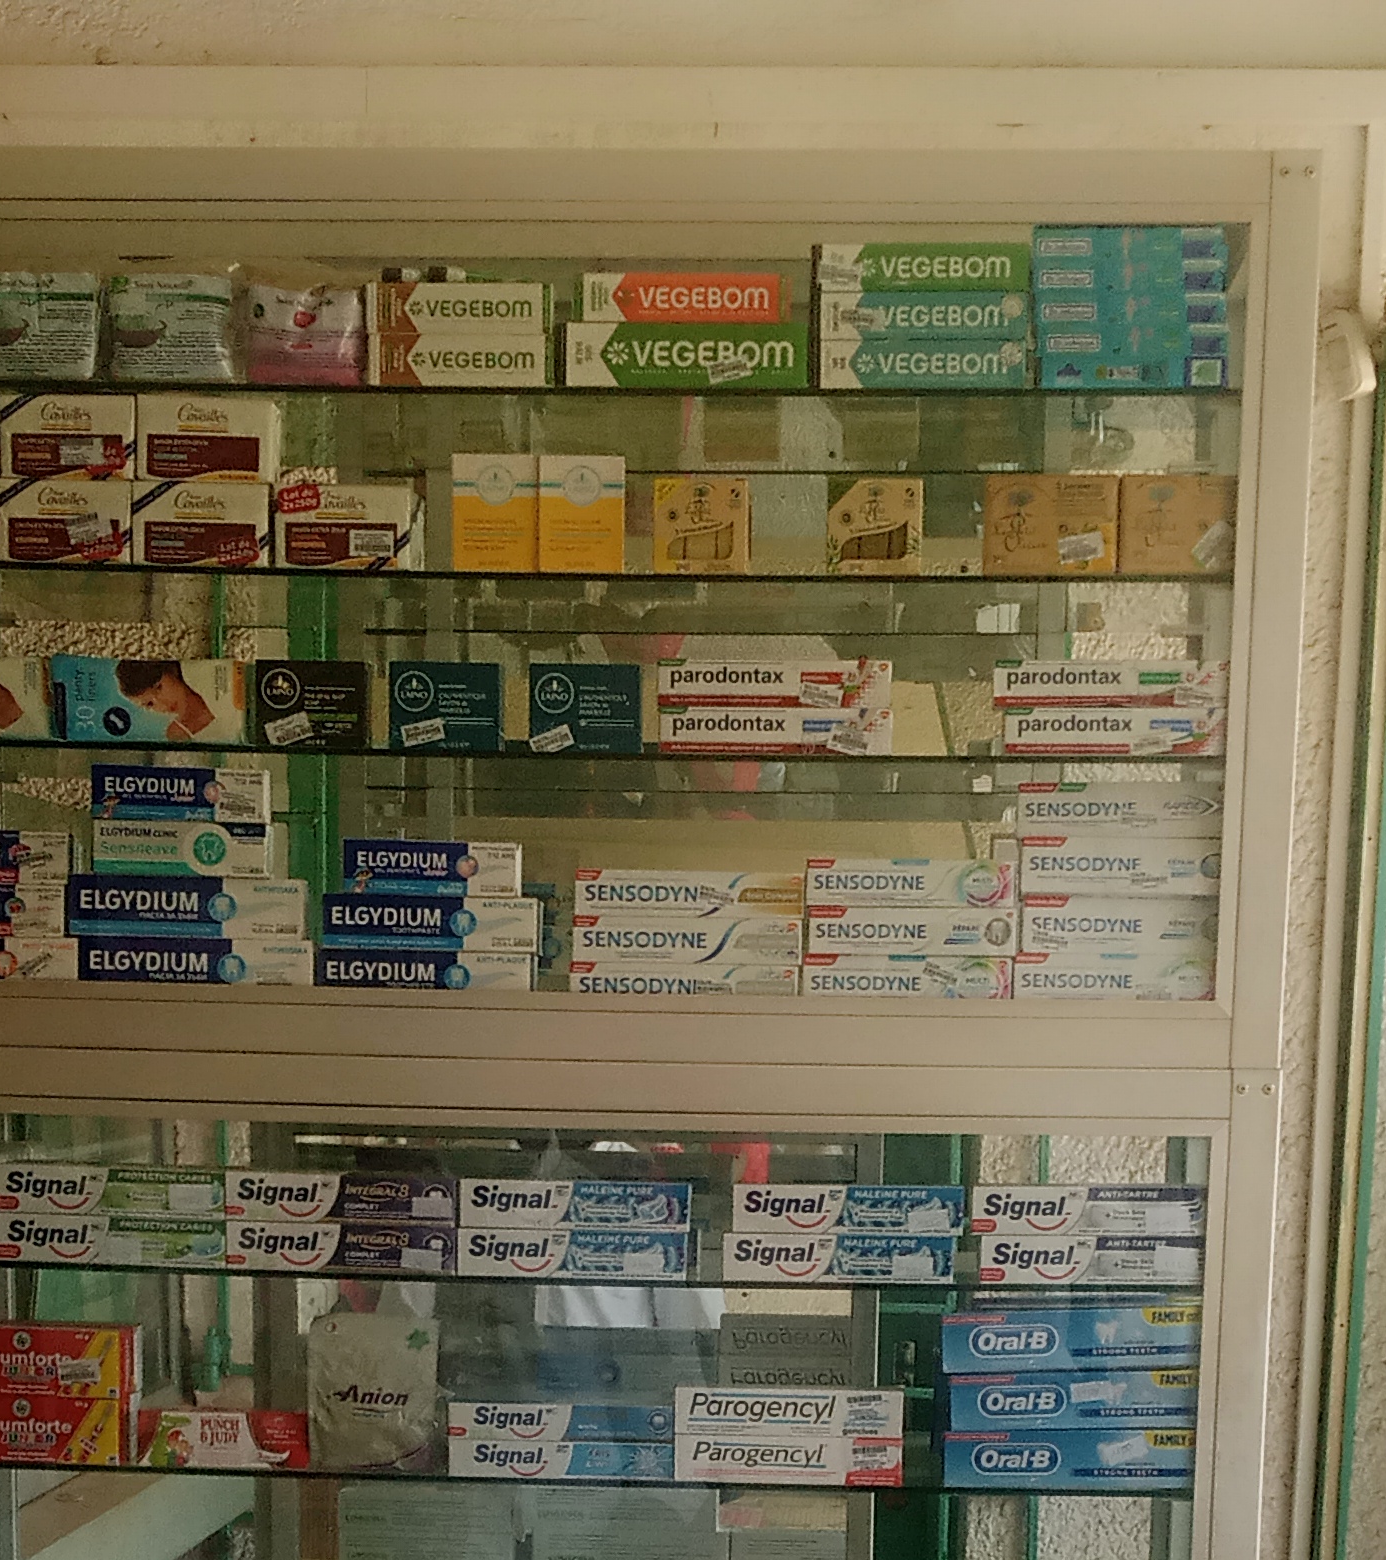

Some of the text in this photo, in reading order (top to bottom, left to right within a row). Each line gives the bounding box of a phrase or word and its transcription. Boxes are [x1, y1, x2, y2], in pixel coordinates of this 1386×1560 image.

[880, 256, 1011, 279] VEGEBOM
[638, 286, 769, 309] VEGEBOM
[426, 300, 532, 317] VEGEBOM
[881, 305, 1010, 327] VEGEBOM
[429, 351, 535, 369] VEGEBOM
[630, 340, 794, 368] VEGEBOM
[878, 353, 1008, 374] VEGEBOM
[670, 667, 783, 688] parodontax
[1007, 667, 1121, 690] parodontax
[672, 714, 785, 736] parodontax
[1018, 715, 1132, 737] parodontax
[104, 777, 195, 795] ELGYDIUM
[357, 851, 448, 869] ELGYDIUM
[1029, 856, 1141, 871] SENSODYNE
[813, 874, 924, 890] SENSODYNE
[80, 889, 199, 912] ELGYDIUM
[585, 885, 698, 902] SENSODYN
[331, 907, 441, 926] ELGYDIUM
[1032, 917, 1142, 933] SENSODYNE
[583, 931, 707, 948] SENSODYNE
[816, 924, 927, 939] SENSODYNE
[90, 951, 208, 972] ELGYDIUM
[326, 962, 435, 981] ELGYDIUM
[811, 975, 921, 991] SENSODYNE
[1021, 974, 1132, 989] SENSODYNE
[6, 1171, 86, 1198] Signal
[118, 1172, 175, 1182] PROTECTION
[238, 1178, 317, 1205] Signal
[471, 1186, 551, 1212] Signal
[744, 1190, 928, 1217] Signal HALEINE PURE
[984, 1194, 1066, 1220] Signal
[8, 1221, 88, 1246] Signal
[239, 1228, 318, 1255] Signal
[469, 1235, 548, 1261] Signal
[734, 1240, 814, 1265] Signal
[993, 1243, 1074, 1269] Signal
[978, 1331, 1048, 1351] Oral-B
[337, 1385, 409, 1406] Anion
[986, 1392, 1056, 1411] Oral-B
[474, 1406, 542, 1429] Signal
[689, 1392, 836, 1424] Parogencyl
[201, 1419, 240, 1431] PUNCH
[210, 1431, 238, 1446] JUDY
[474, 1444, 543, 1466] Signal
[693, 1442, 823, 1467] Parogencyl
[980, 1450, 1050, 1469] Oral-B
